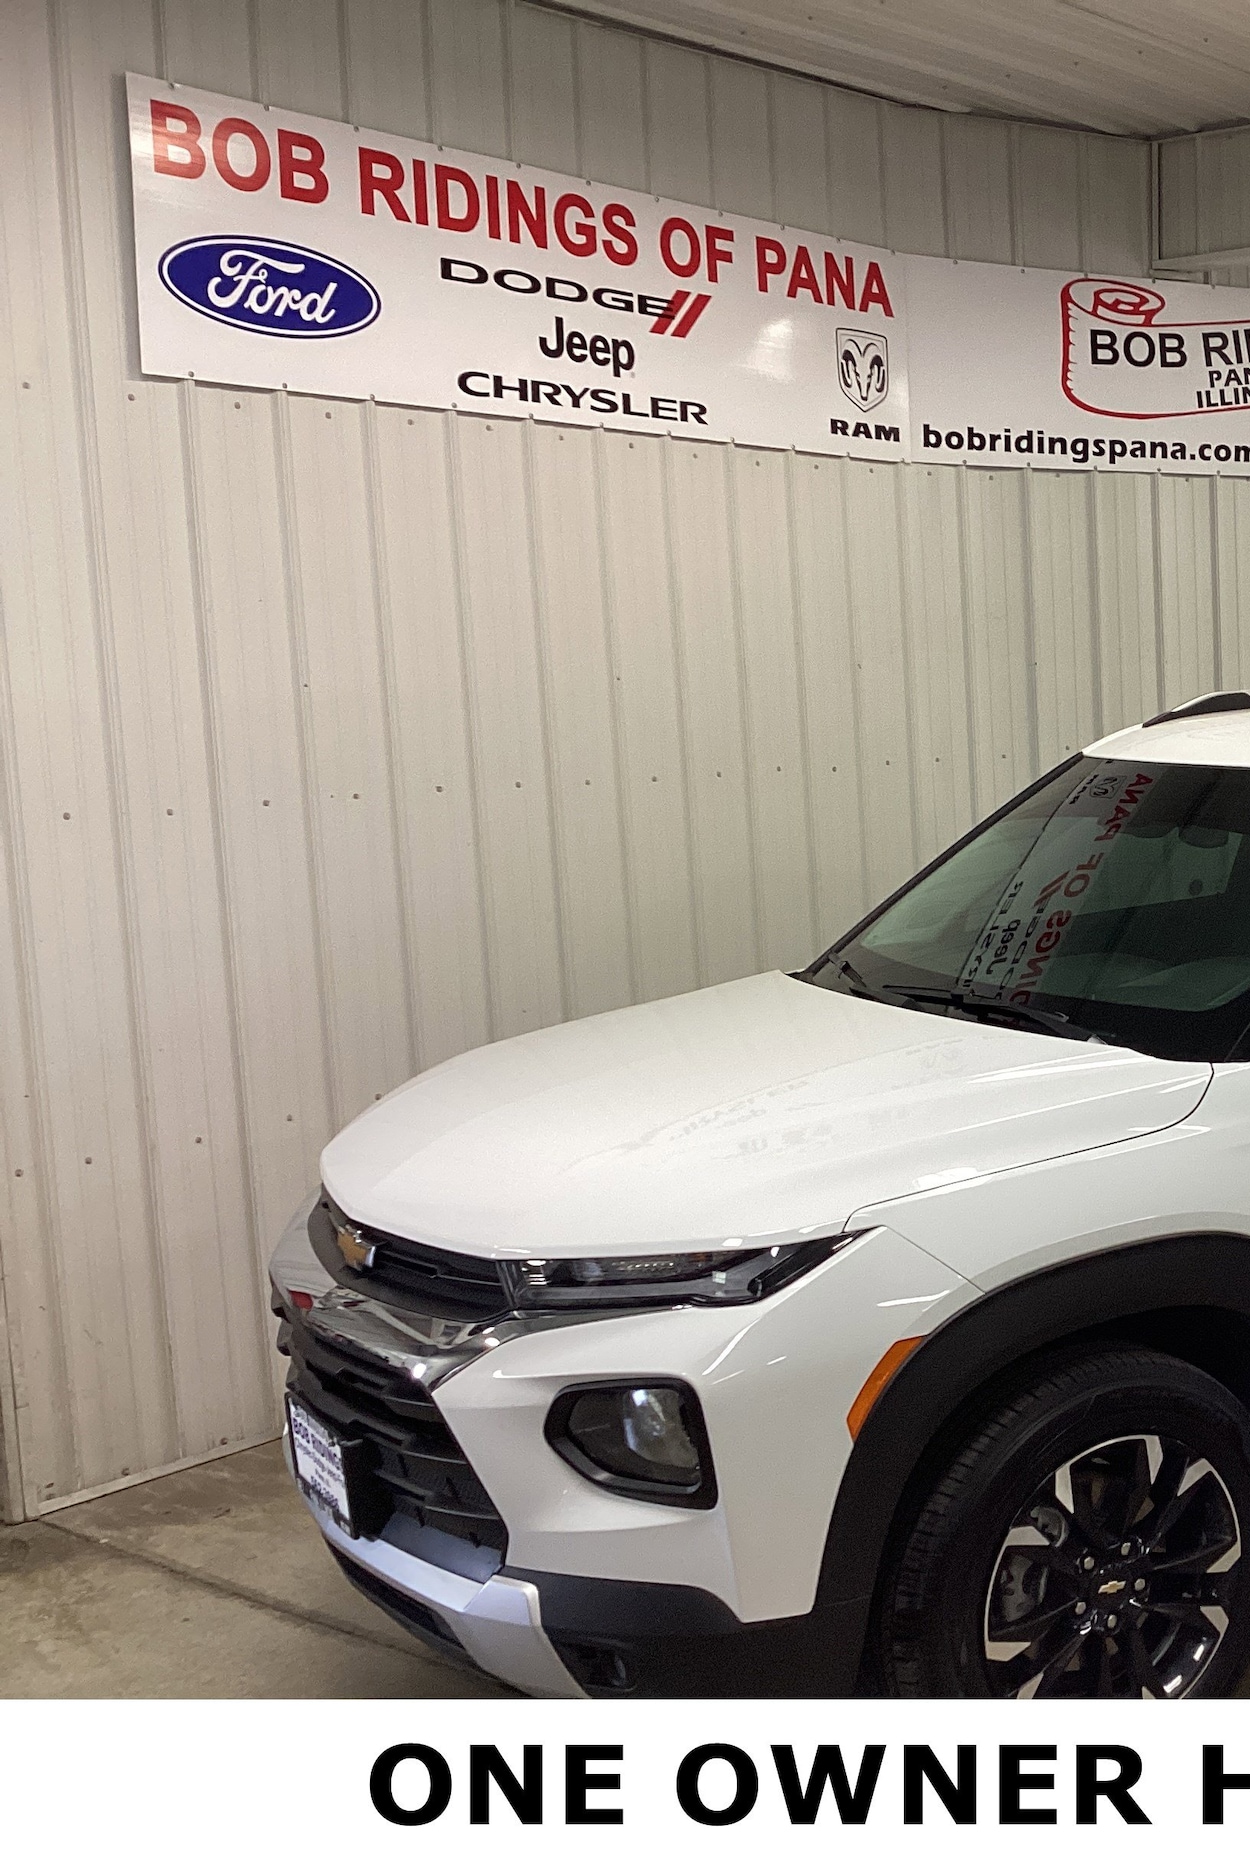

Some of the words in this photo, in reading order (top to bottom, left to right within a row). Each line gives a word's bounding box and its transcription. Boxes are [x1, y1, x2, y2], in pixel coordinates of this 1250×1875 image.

[150, 100, 330, 205] BOB
[358, 147, 639, 268] RIDINGS
[660, 217, 735, 284] OF
[755, 236, 895, 318] PANA
[207, 249, 338, 324] Ford
[441, 258, 676, 319] DODGE
[539, 317, 635, 378] Jeep
[1090, 329, 1188, 368] BOB
[457, 371, 709, 426] CHRYSLER
[830, 418, 900, 443] RAM
